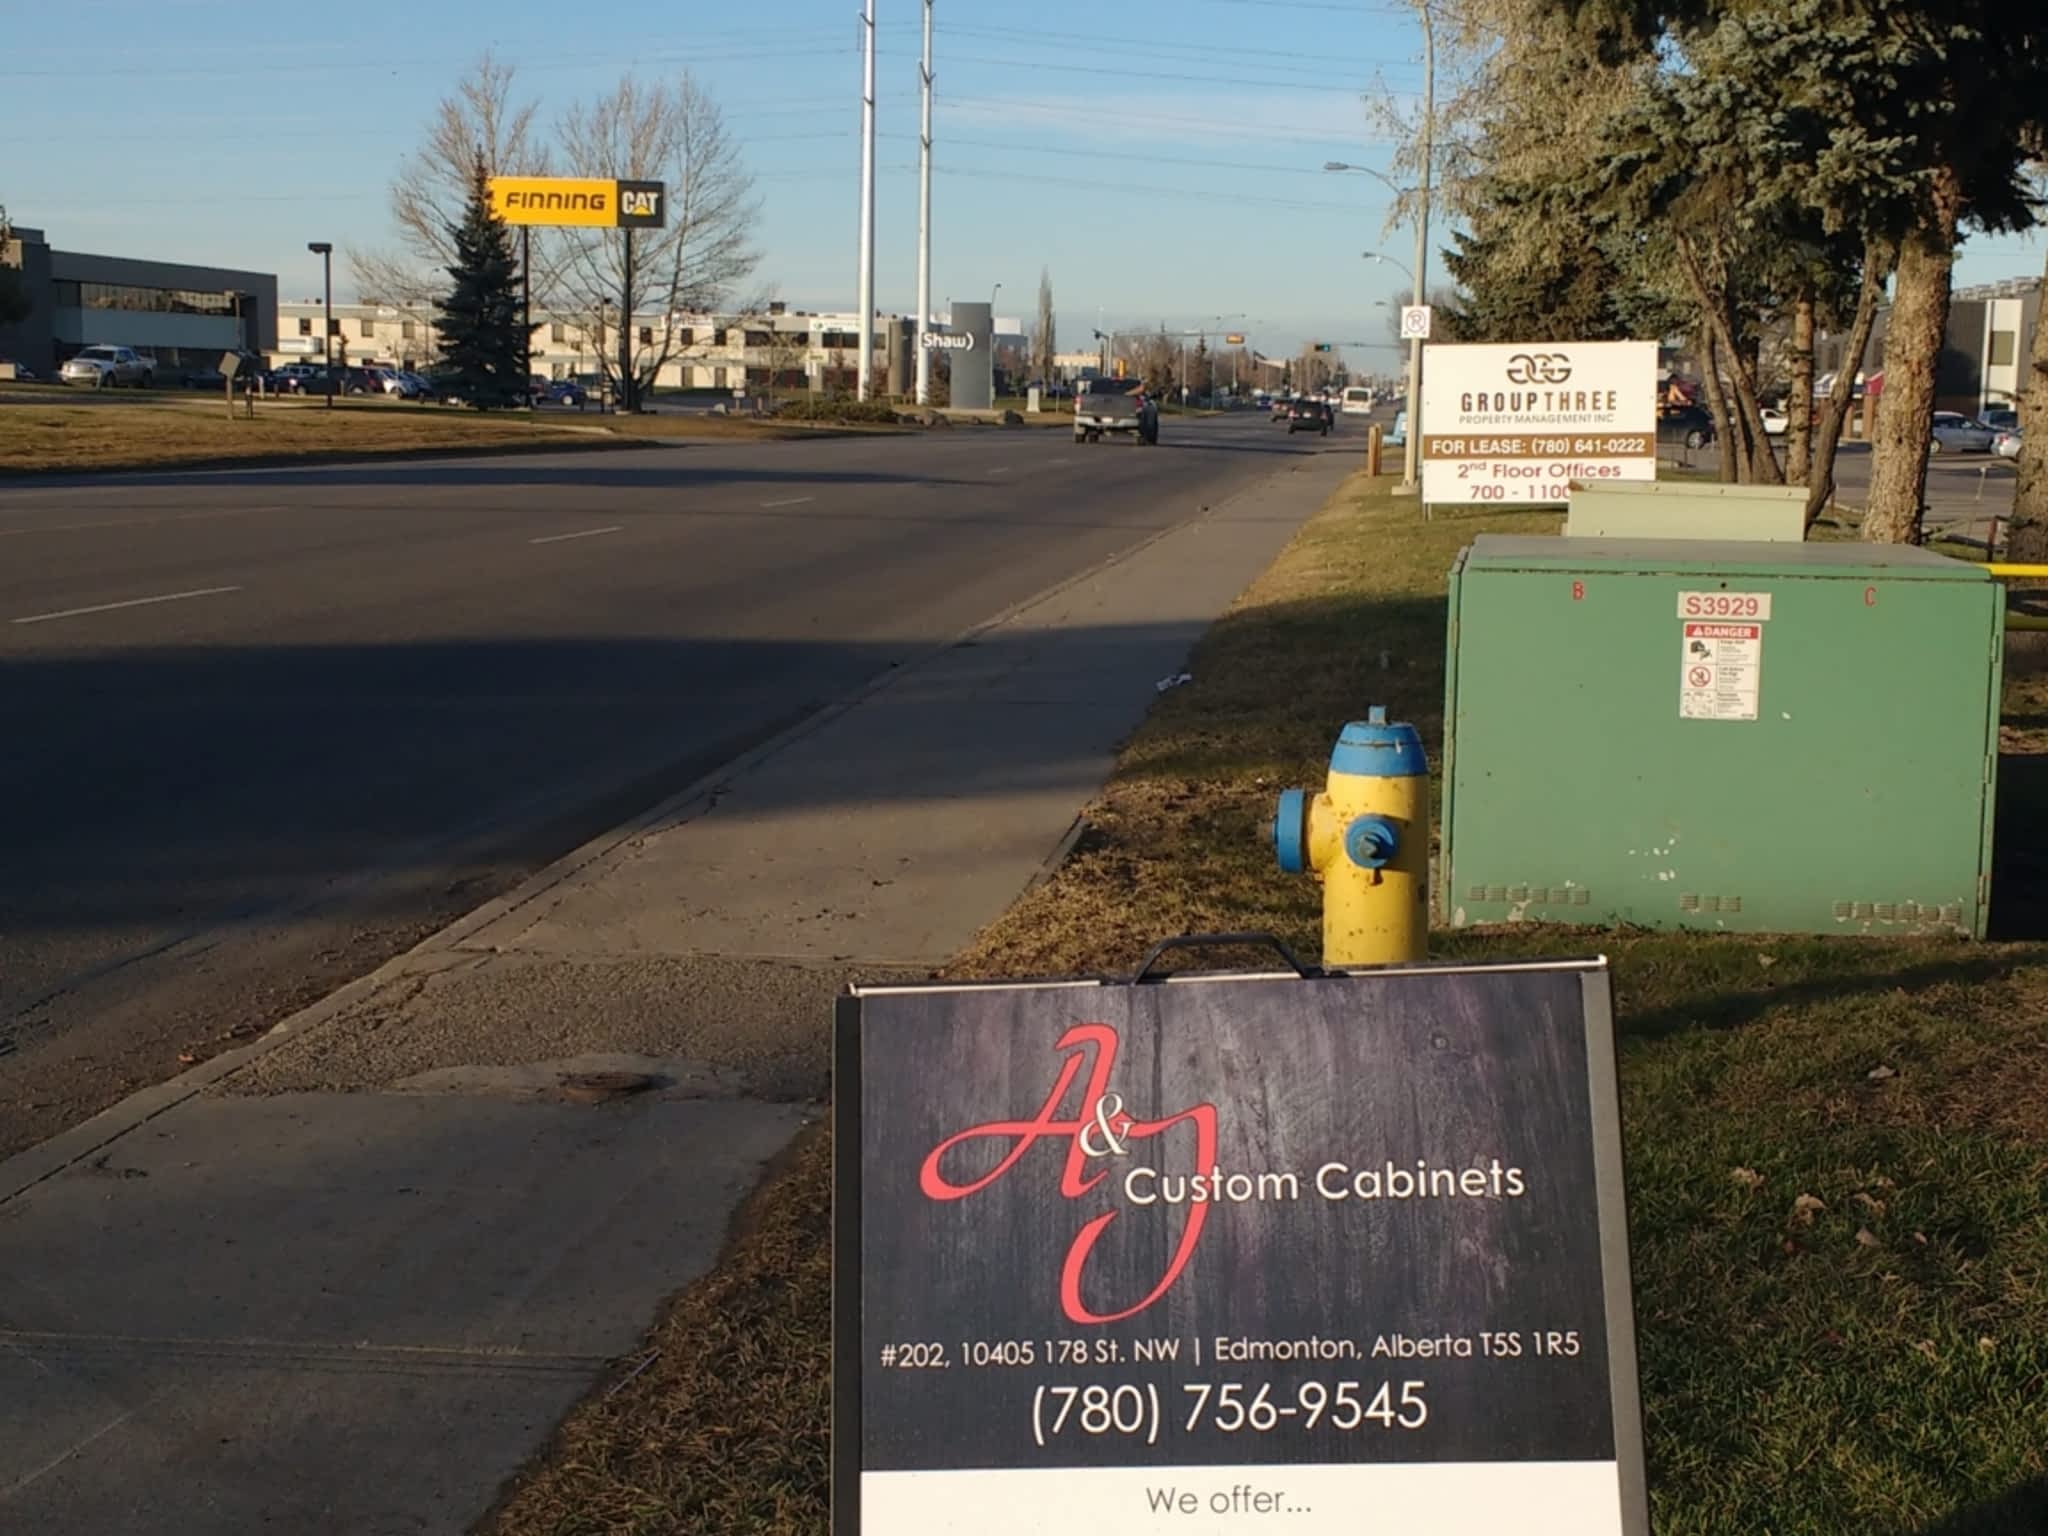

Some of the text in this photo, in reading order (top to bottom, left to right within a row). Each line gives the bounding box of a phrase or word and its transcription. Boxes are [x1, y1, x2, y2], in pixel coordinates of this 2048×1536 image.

[506, 192, 606, 210] FINNING
[622, 191, 658, 215] CAT
[1459, 415, 1512, 424] PROPERTY
[1514, 414, 1592, 424] MANAGEMENT
[1432, 438, 1645, 454] FOR LEASE: (780) 641-0222
[1458, 462, 1621, 479] 2nd Floor Offices
[1471, 485, 1504, 499] 700
[1572, 582, 1584, 600] B
[1864, 587, 1876, 606] C
[1686, 596, 1758, 616] S3929
[1704, 626, 1751, 638] DANGER
[1124, 1159, 1526, 1204] Custom Cabinets
[881, 1343, 951, 1368] #202,
[962, 1341, 1034, 1365] 10405
[1045, 1339, 1088, 1363] 178
[1095, 1339, 1125, 1362] St.
[1134, 1338, 1180, 1362] NW
[1215, 1335, 1362, 1361] Edmonton,
[1371, 1333, 1472, 1358] Alberta
[1480, 1331, 1522, 1356] T5S
[1535, 1331, 1581, 1356] 1R5
[1033, 1381, 1429, 1446] (780) 756-9545
[1146, 1485, 1312, 1514] We offer...
